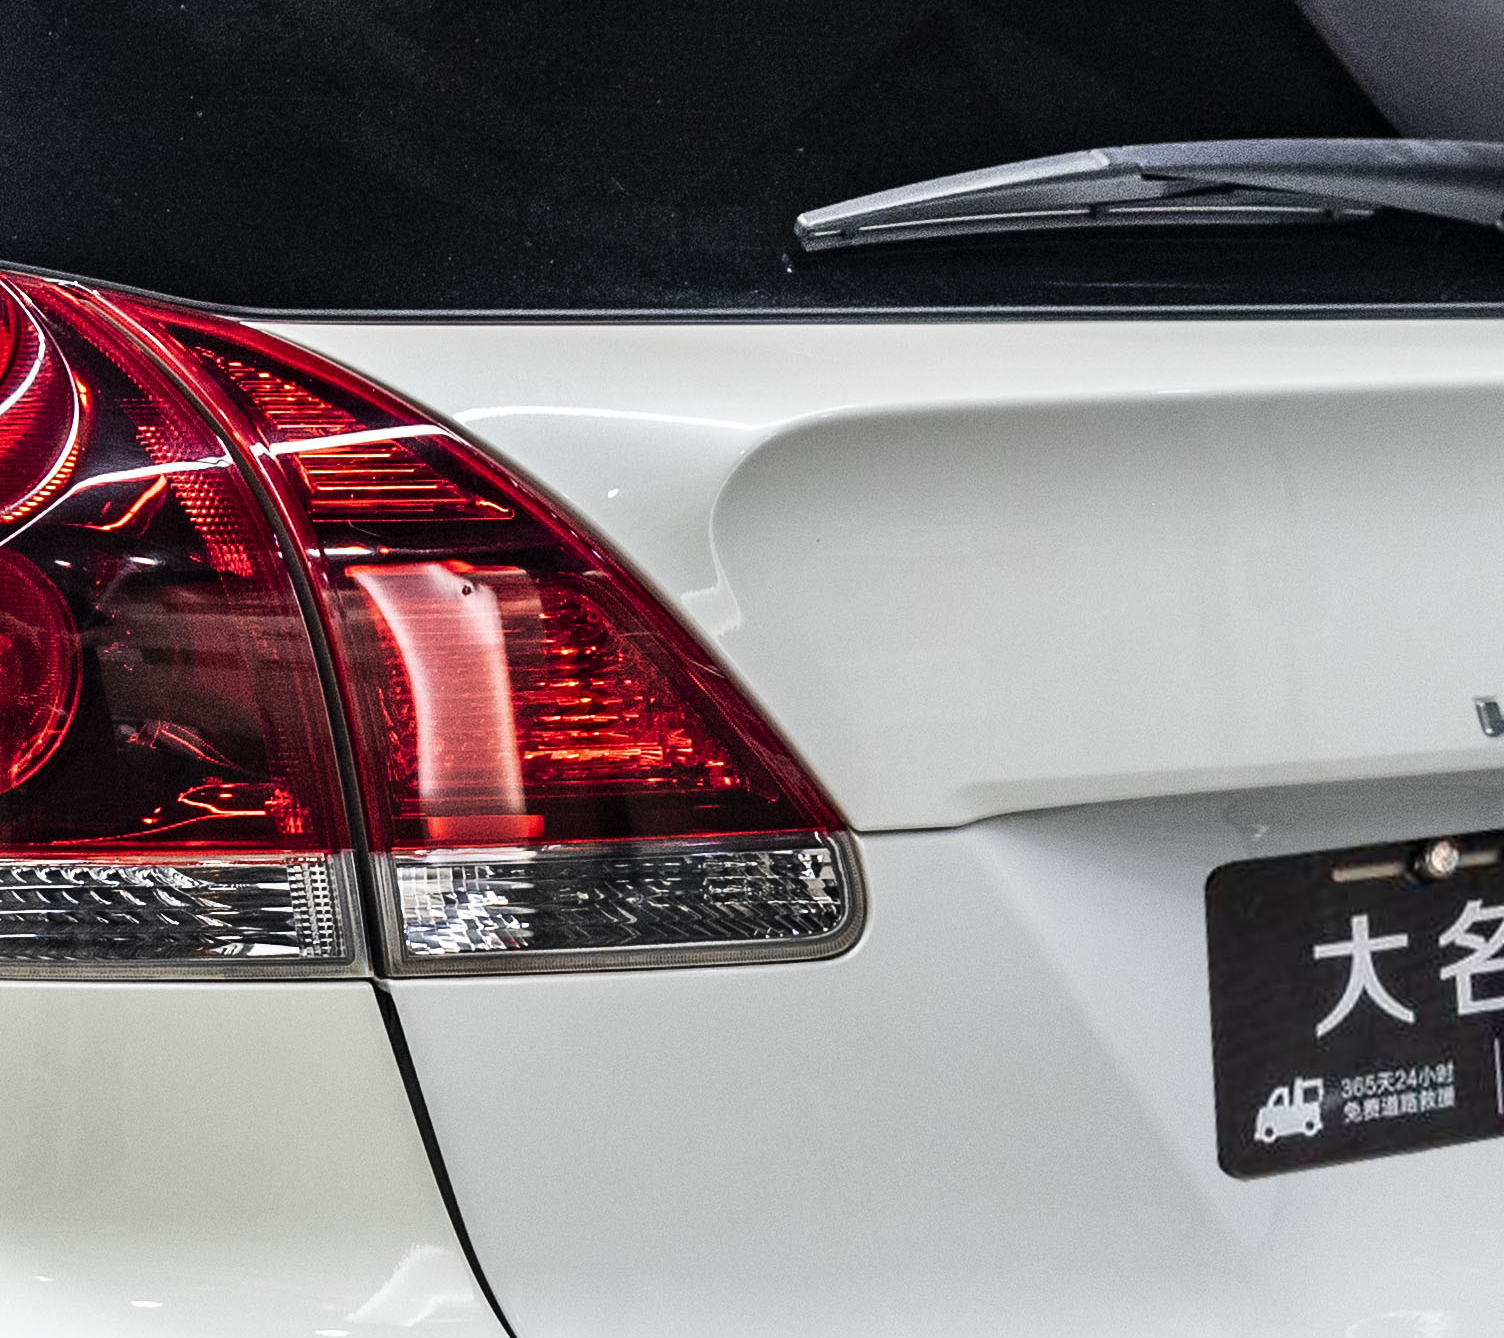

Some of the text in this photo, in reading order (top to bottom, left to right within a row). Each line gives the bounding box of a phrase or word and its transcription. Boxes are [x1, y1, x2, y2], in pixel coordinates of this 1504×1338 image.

[1341, 1060, 1455, 1099] 365天24小时
[1343, 1084, 1456, 1125] 免费道路救援
